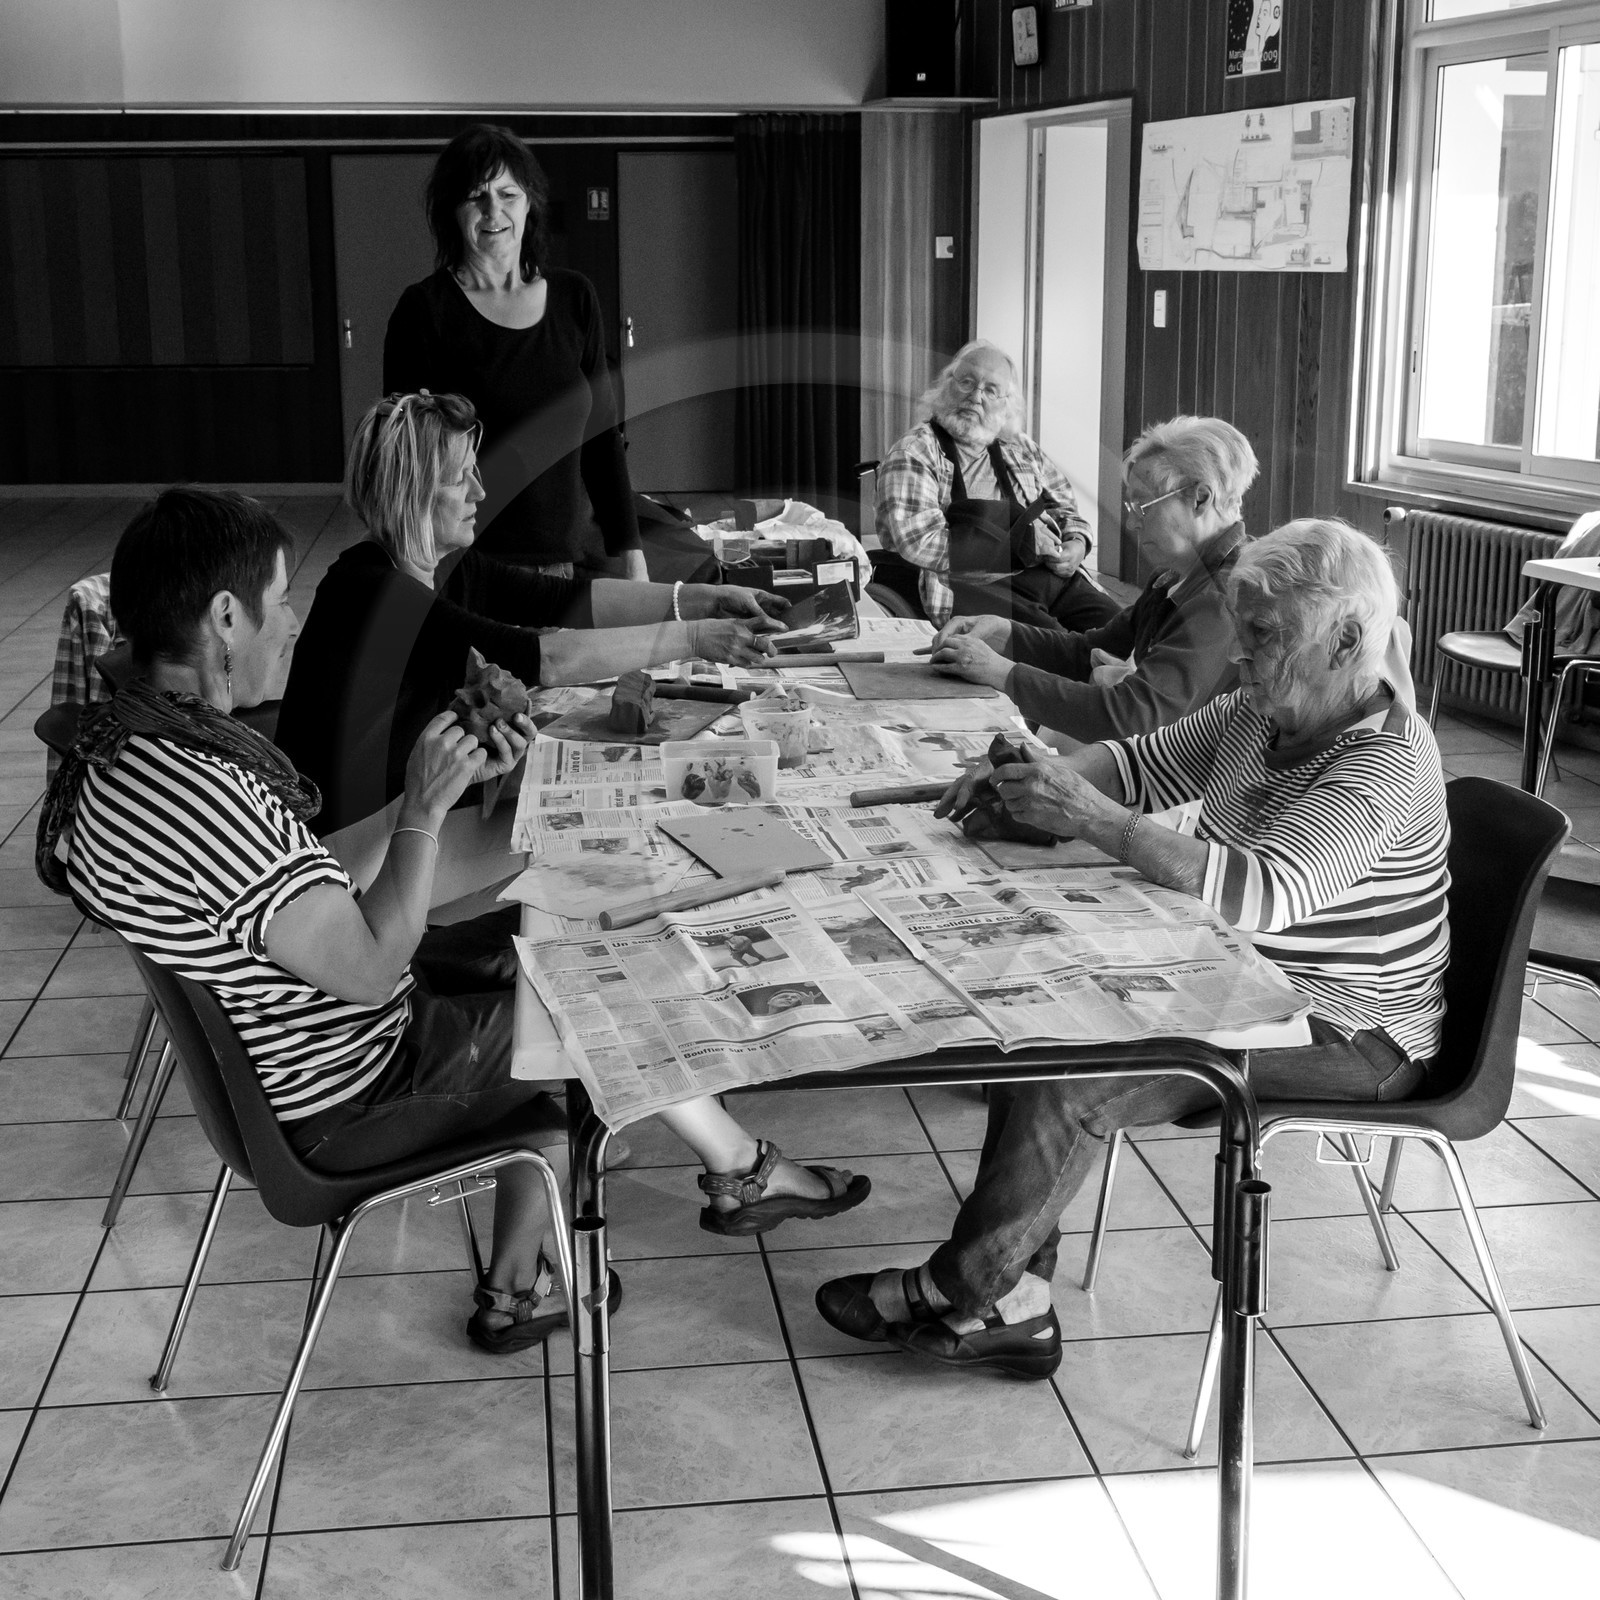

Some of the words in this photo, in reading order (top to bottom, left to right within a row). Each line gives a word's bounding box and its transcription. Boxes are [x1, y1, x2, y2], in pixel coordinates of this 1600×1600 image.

[899, 908, 964, 921] SPORTS
[908, 924, 933, 932] Une
[936, 918, 981, 929] solidité
[995, 909, 1051, 921] confmer
[632, 937, 662, 946] souci
[664, 930, 676, 941] de
[705, 928, 731, 937] pour
[733, 913, 797, 930] Deschamps
[1176, 967, 1191, 975] fin
